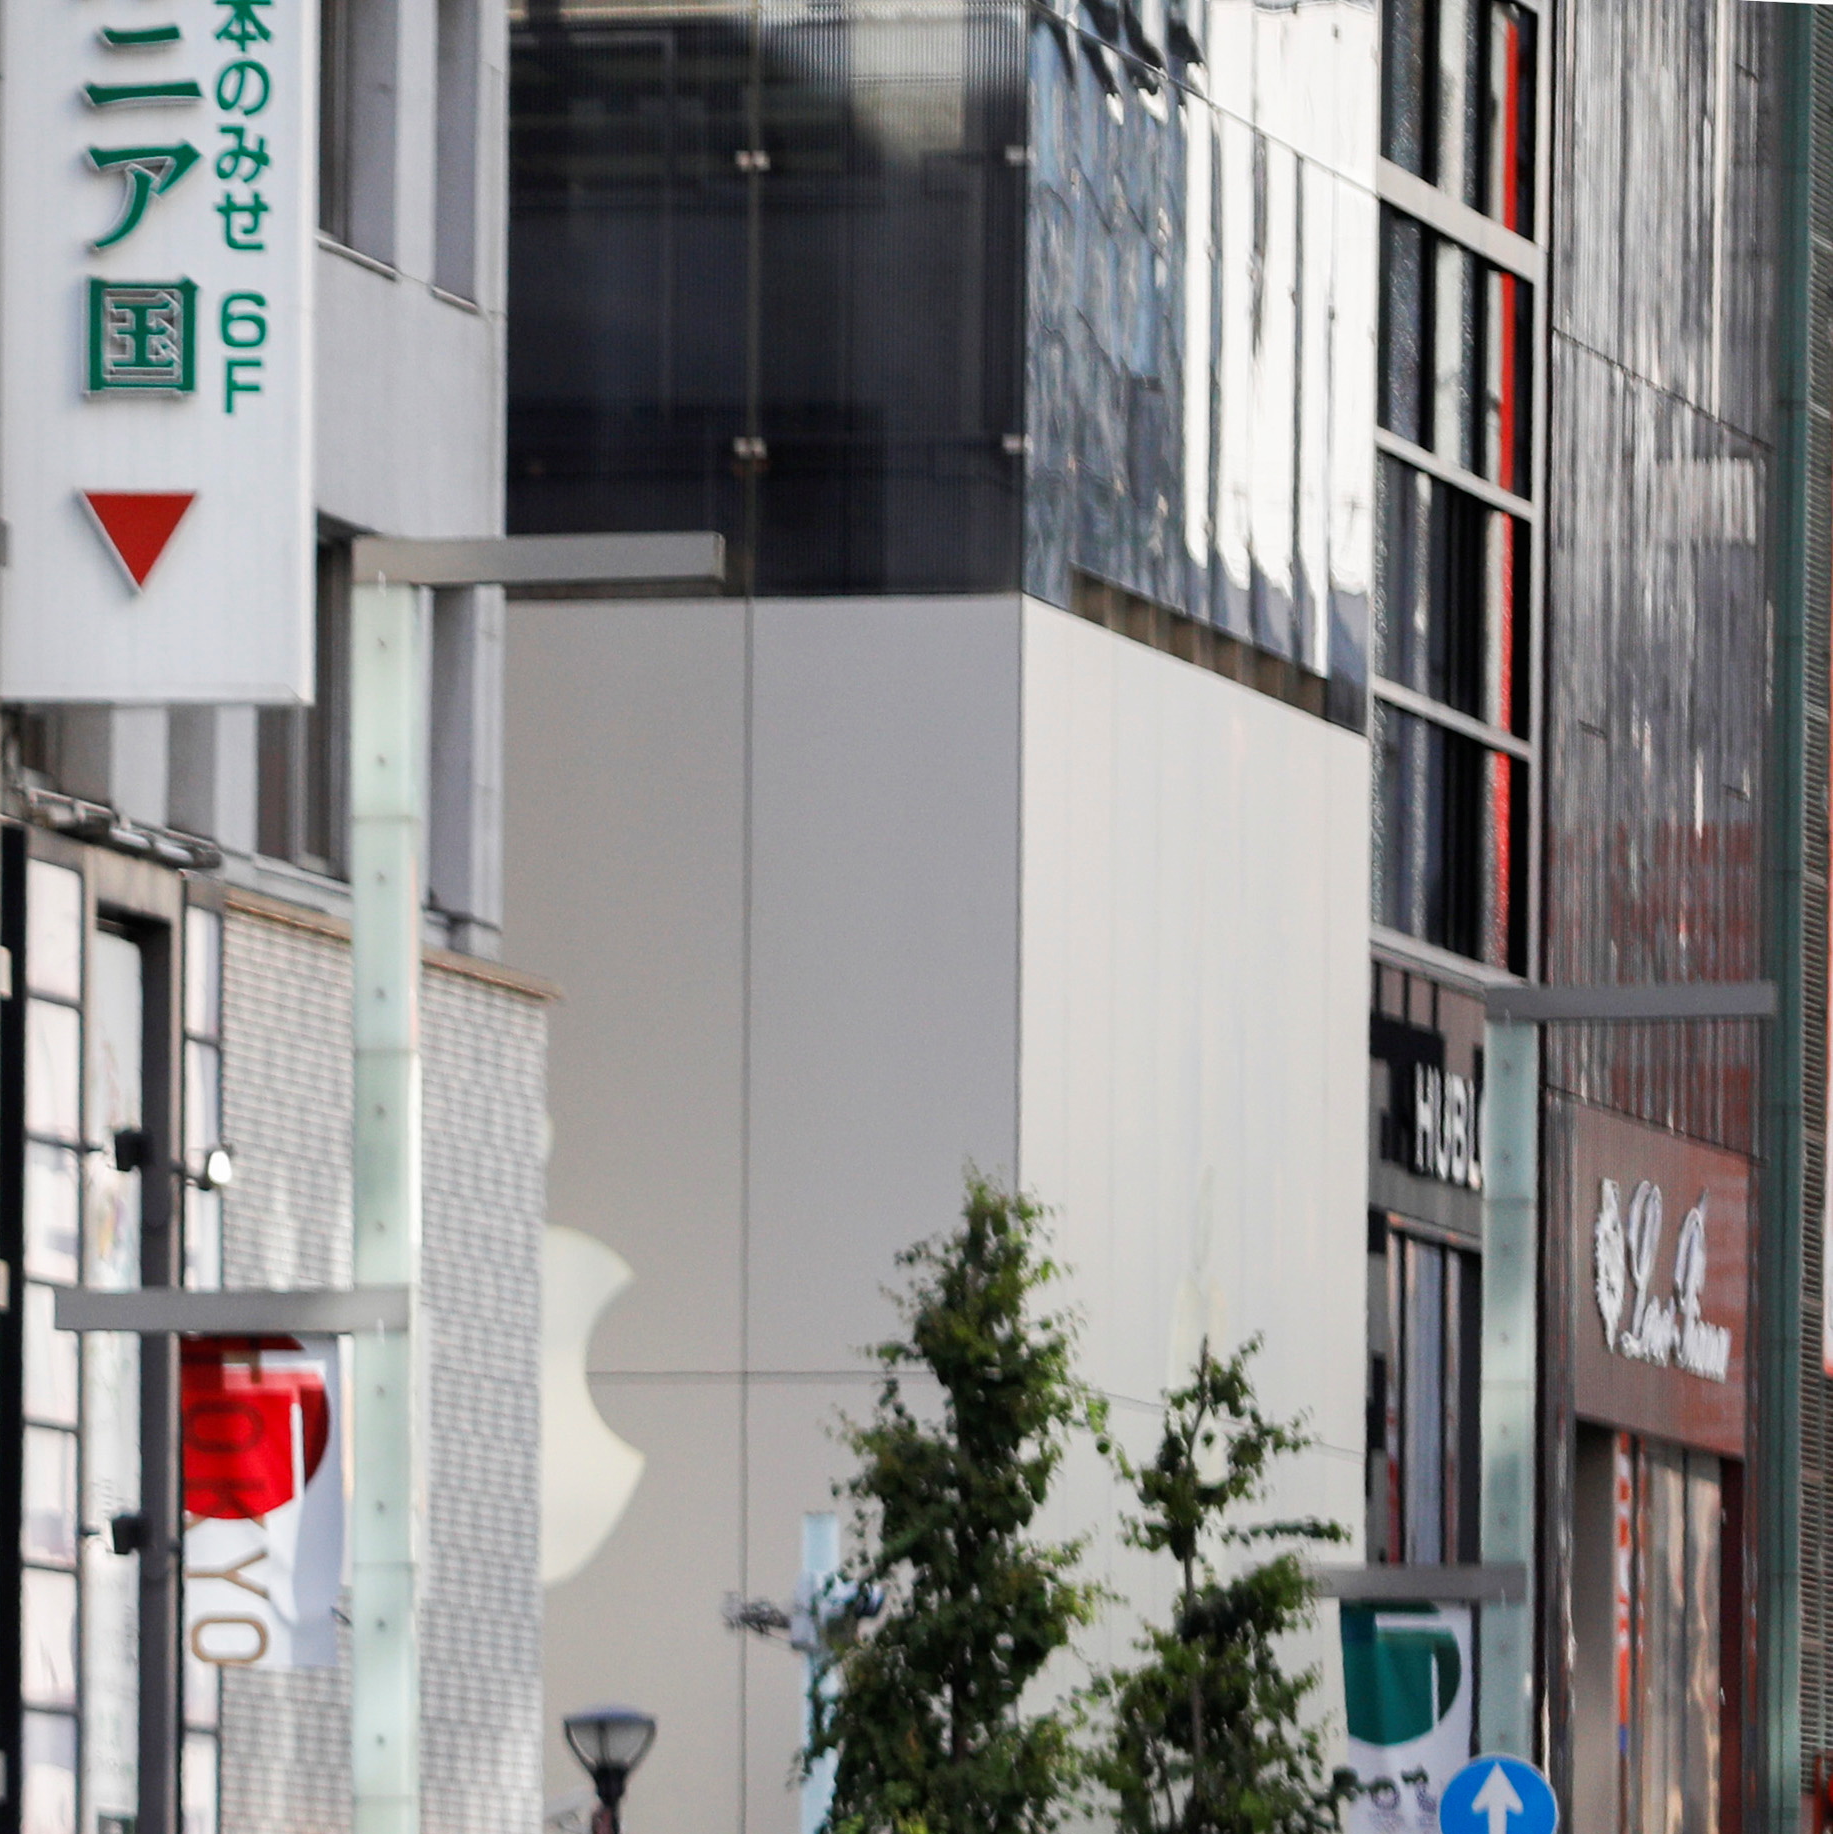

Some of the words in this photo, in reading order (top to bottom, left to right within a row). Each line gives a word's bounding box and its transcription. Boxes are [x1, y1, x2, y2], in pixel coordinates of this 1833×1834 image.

[82, 0, 205, 394] ニア国
[219, 292, 267, 415] 6F
